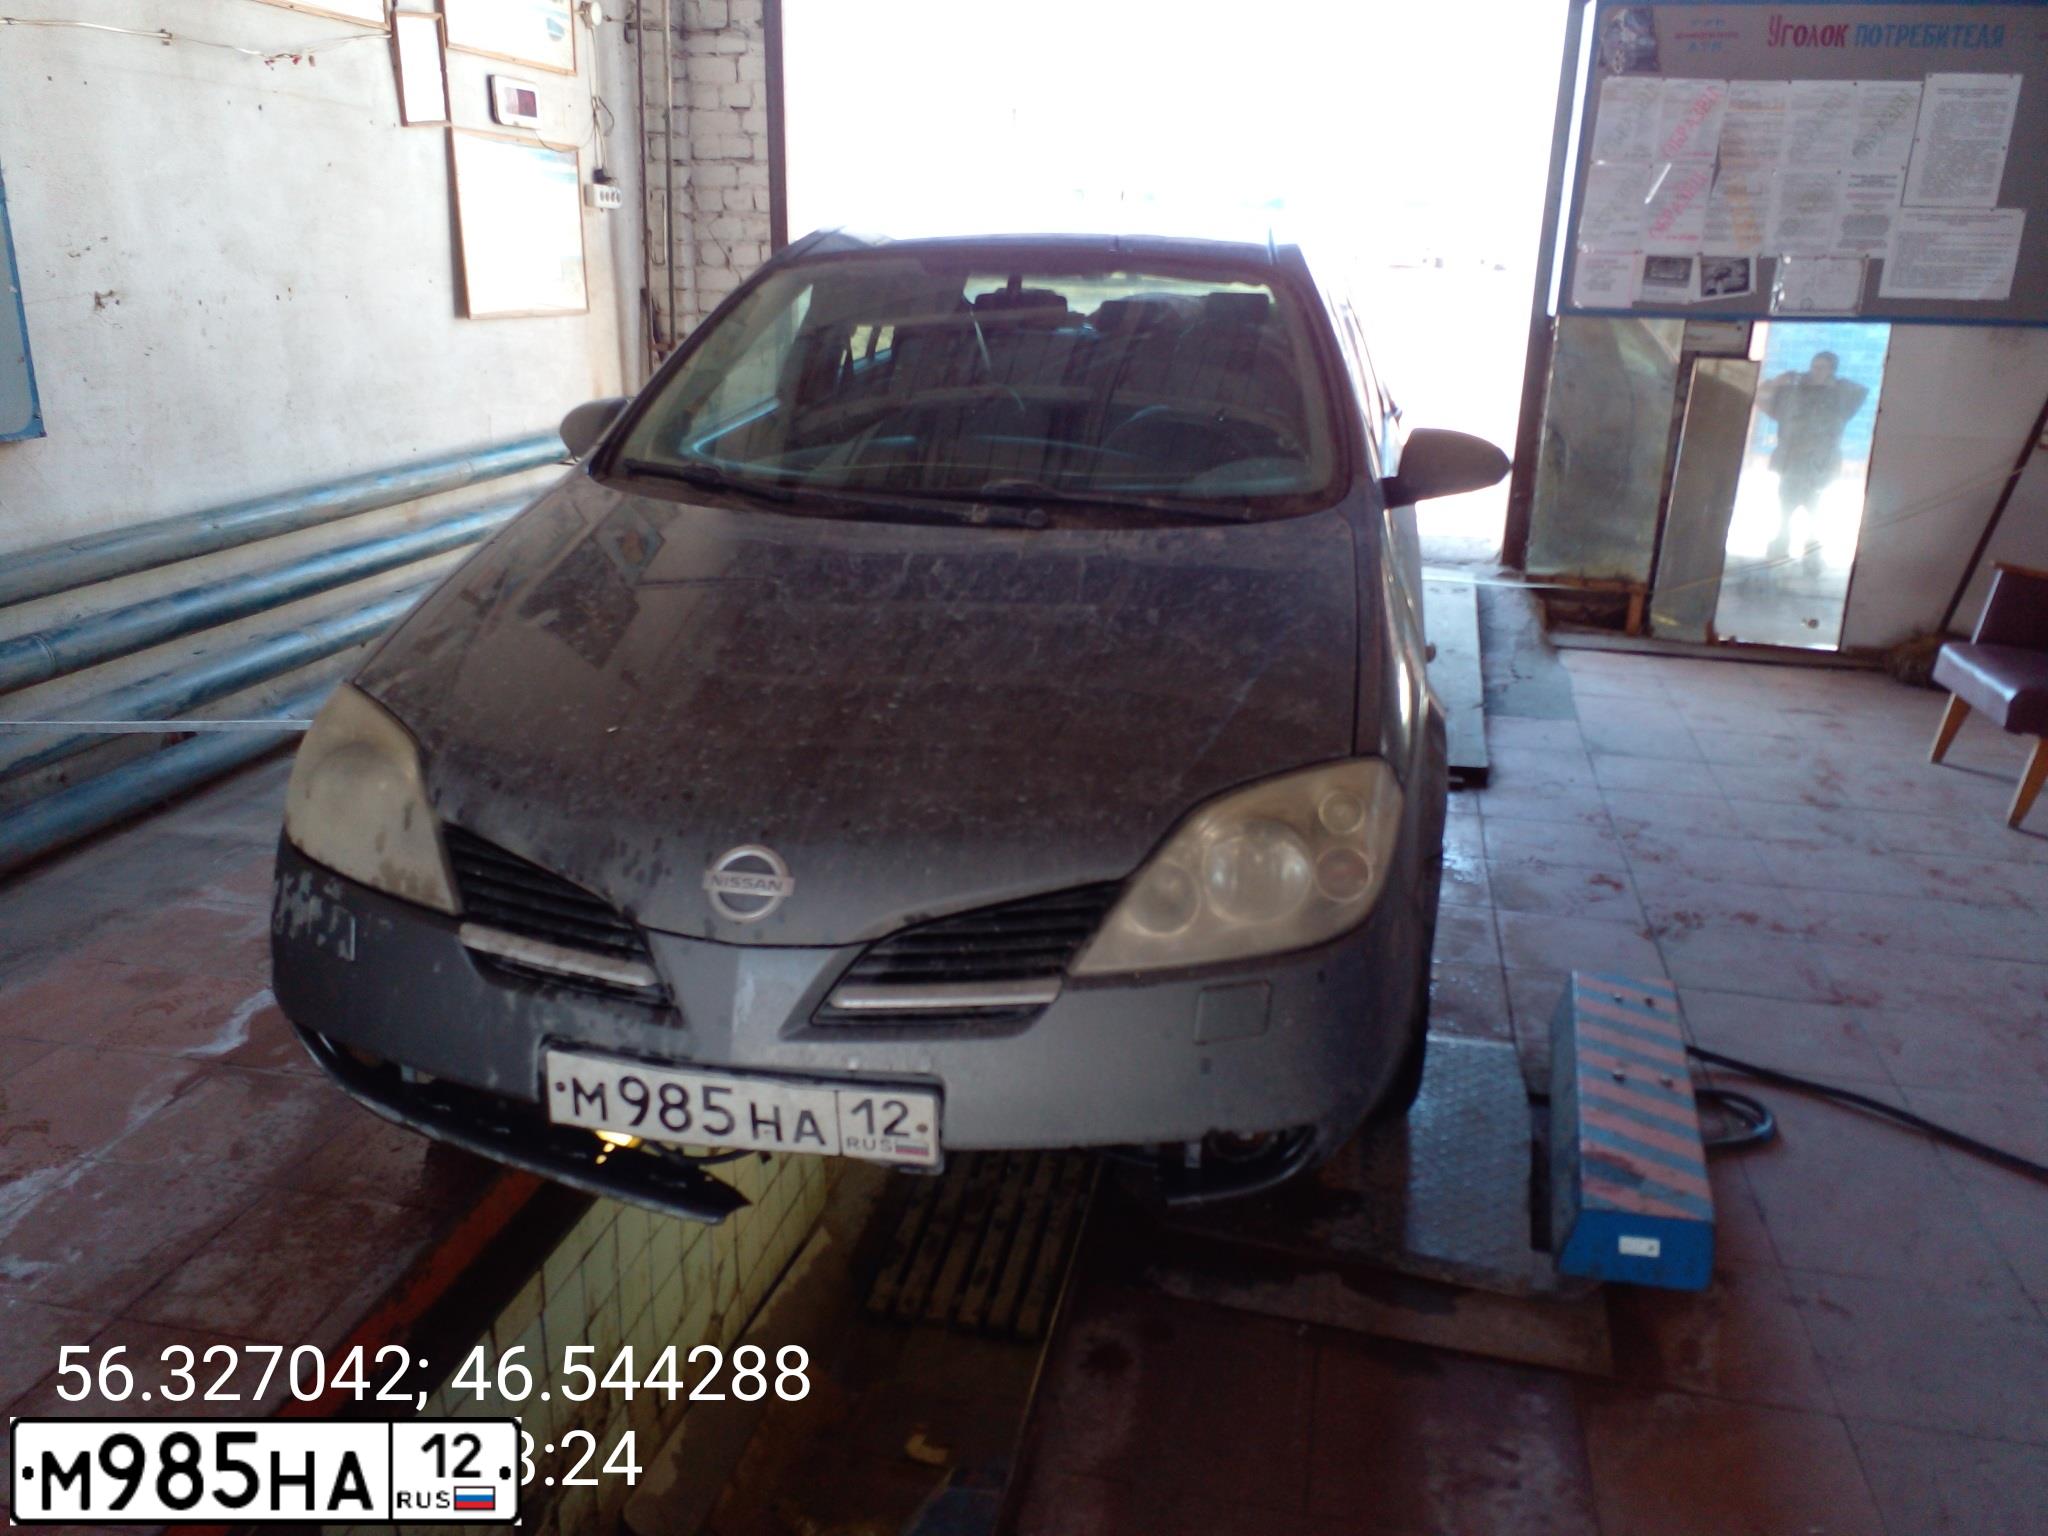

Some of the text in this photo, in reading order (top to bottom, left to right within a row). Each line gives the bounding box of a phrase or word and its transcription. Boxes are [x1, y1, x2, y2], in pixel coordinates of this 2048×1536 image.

[1855, 23, 2006, 49] ПОТРЕБИТЕЛЯ
[712, 874, 784, 892] NISSAN
[570, 1075, 910, 1146] М985НА 12
[846, 1136, 893, 1153] RUS
